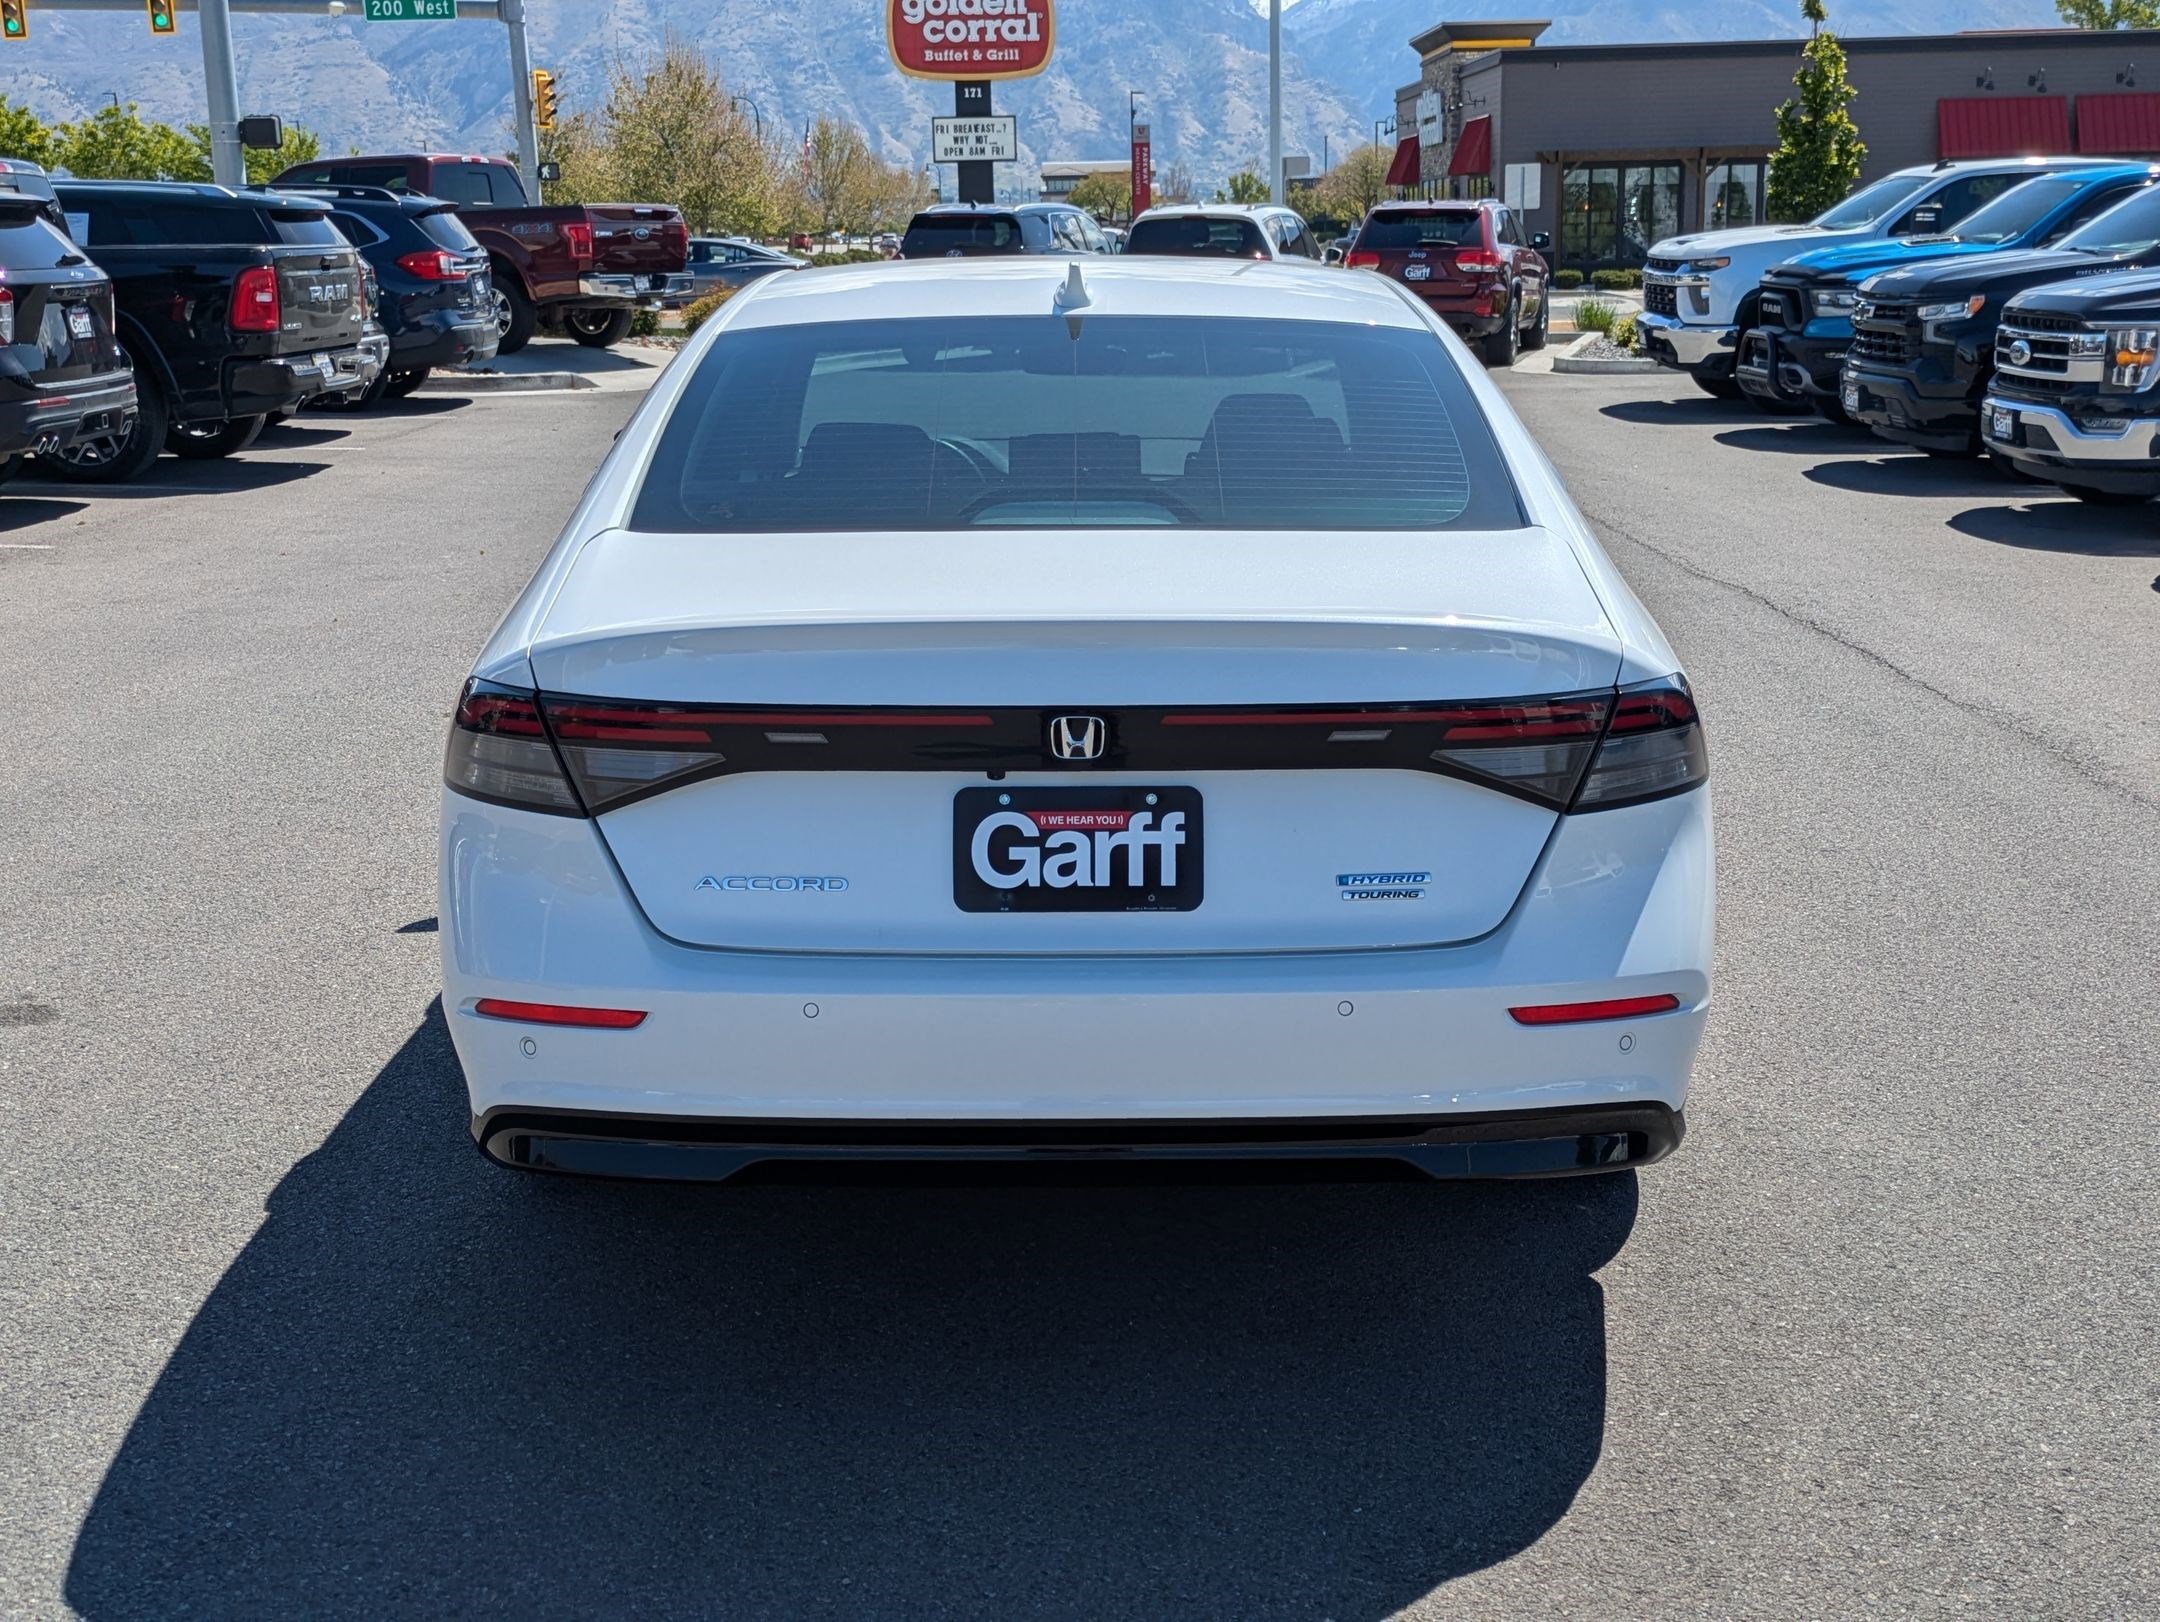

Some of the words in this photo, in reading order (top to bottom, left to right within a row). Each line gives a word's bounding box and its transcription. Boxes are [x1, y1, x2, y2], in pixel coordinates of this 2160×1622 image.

[371, 0, 403, 16] 200
[413, 0, 449, 15] West
[923, 12, 1041, 43] corral
[924, 50, 969, 61] Buffet
[972, 50, 983, 61] &
[986, 49, 1020, 61] Grill
[964, 87, 983, 98] 171
[935, 124, 949, 134] FRI
[953, 135, 969, 145] WHY
[943, 147, 964, 157] OPEN
[969, 146, 986, 156] 8AM
[991, 145, 1005, 156] FRI
[1407, 249, 1427, 259] Jeep
[1404, 266, 1431, 278] Garff
[309, 284, 349, 303] RAM
[1762, 303, 1782, 314] RAM
[1048, 816, 1064, 825] WE
[1066, 815, 1094, 825] HEAR
[1095, 815, 1116, 825] YOU
[971, 811, 1186, 889] Garff
[695, 876, 850, 891] ACCORD
[1352, 874, 1426, 884] HYBRID
[1347, 890, 1420, 899] TOURING
